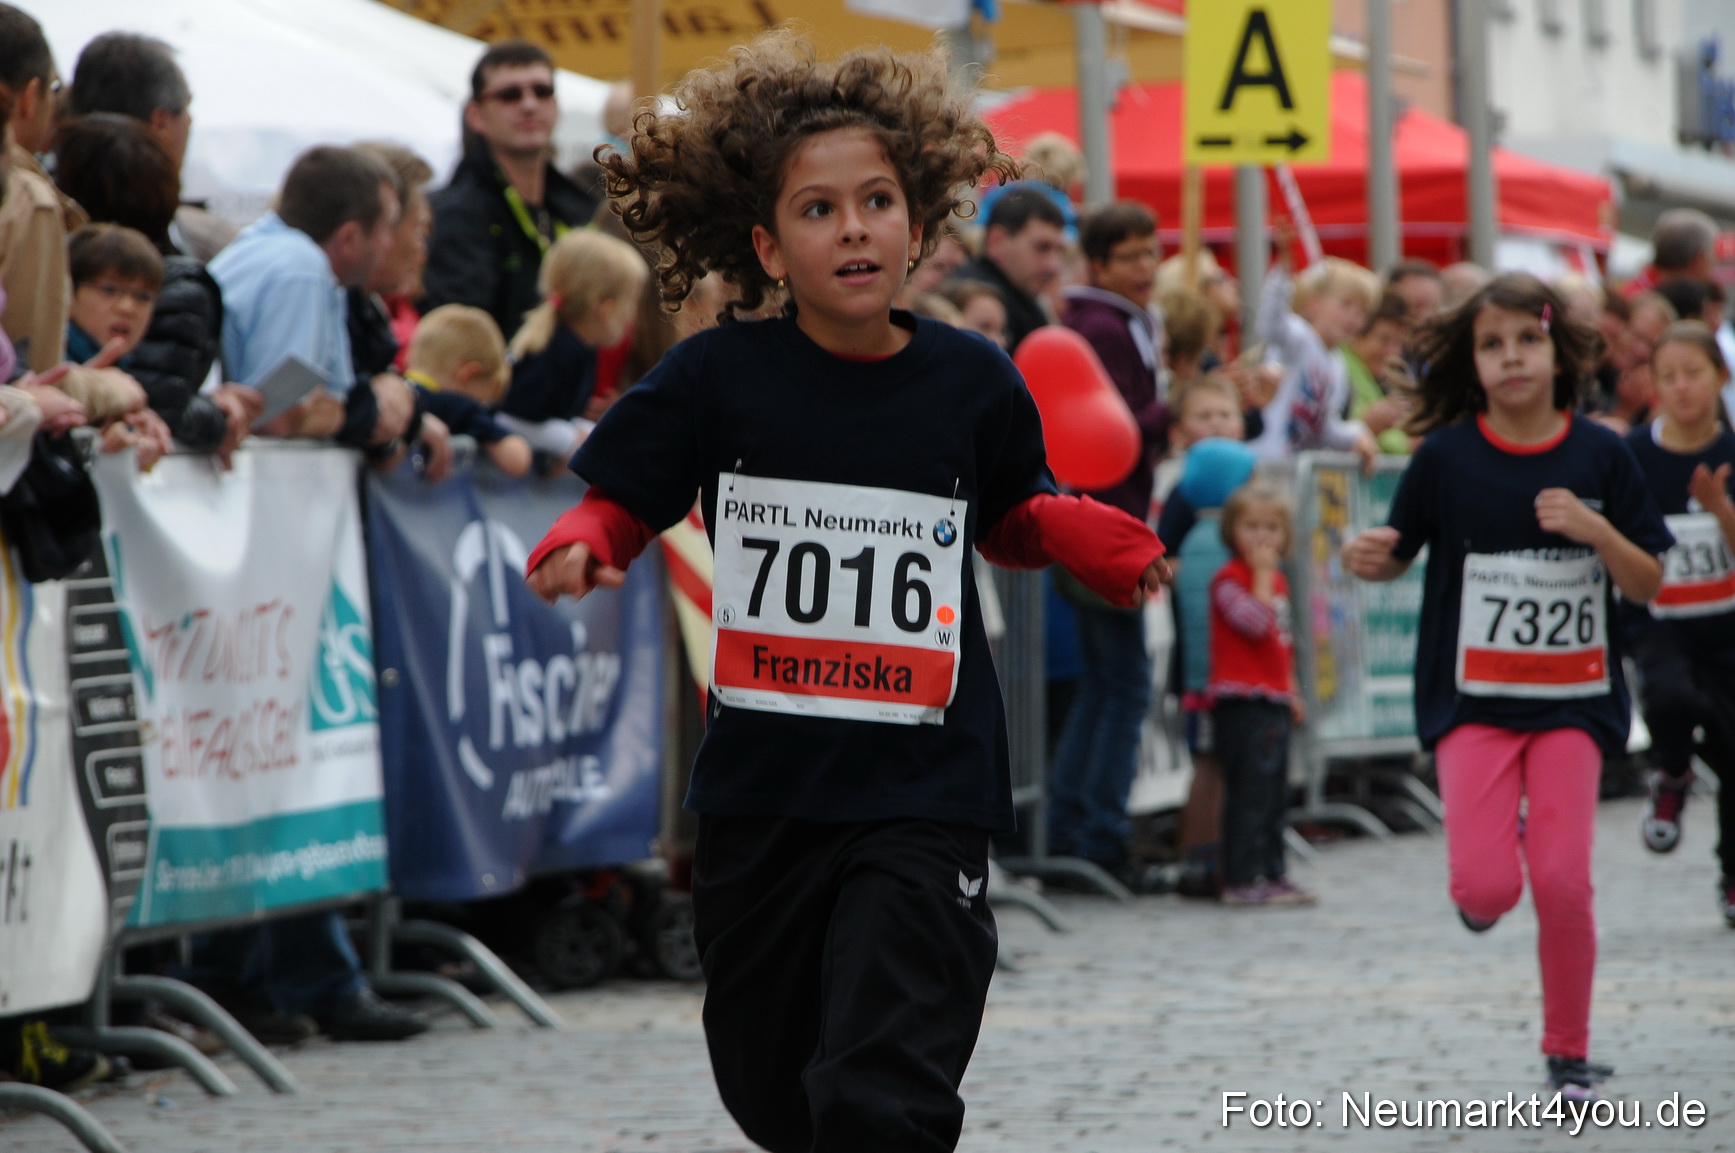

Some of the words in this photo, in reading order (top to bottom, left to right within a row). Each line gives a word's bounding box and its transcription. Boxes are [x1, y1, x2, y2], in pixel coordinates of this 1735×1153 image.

[1218, 10, 1294, 109] A
[724, 499, 797, 528] PARTL
[804, 509, 923, 540] Neumarkt
[742, 536, 932, 633] 7016
[722, 608, 731, 623] 5
[938, 631, 951, 645] W
[1483, 596, 1593, 645] 7326
[753, 645, 912, 693] Franziska
